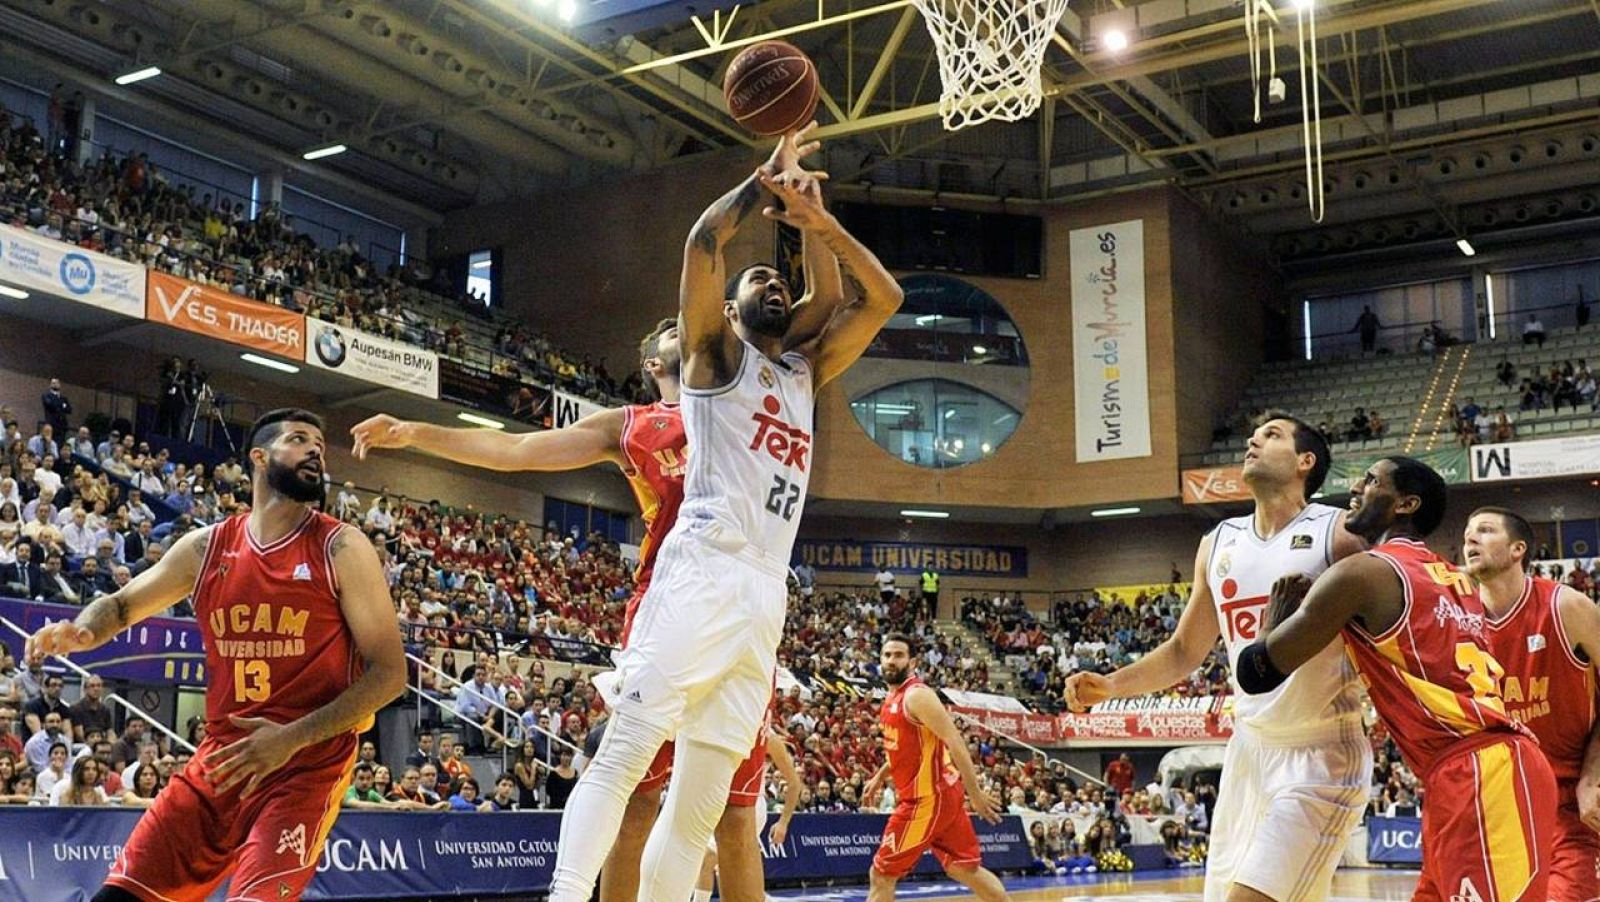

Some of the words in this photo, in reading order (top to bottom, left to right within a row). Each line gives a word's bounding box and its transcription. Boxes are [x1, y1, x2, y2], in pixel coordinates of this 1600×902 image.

[226, 312, 300, 347] THADER
[403, 353, 433, 372] BMW
[765, 474, 801, 522] 22
[803, 544, 862, 566] UCAM
[872, 547, 1012, 571] UNIVERSIDAD
[210, 603, 310, 638] UCAM
[234, 659, 271, 703] 13
[434, 840, 516, 855] UNIVERSIDAD
[519, 838, 559, 854] CATÓLI
[800, 834, 851, 847] UNIVERSIDAD
[852, 833, 882, 846] CATÓLIC
[1382, 830, 1423, 849] UCA
[53, 843, 123, 861] UNIVER
[824, 846, 839, 857] SAN
[840, 846, 871, 856] ANTONIO
[471, 856, 494, 869] SAN
[497, 856, 546, 868] ANTONIO
